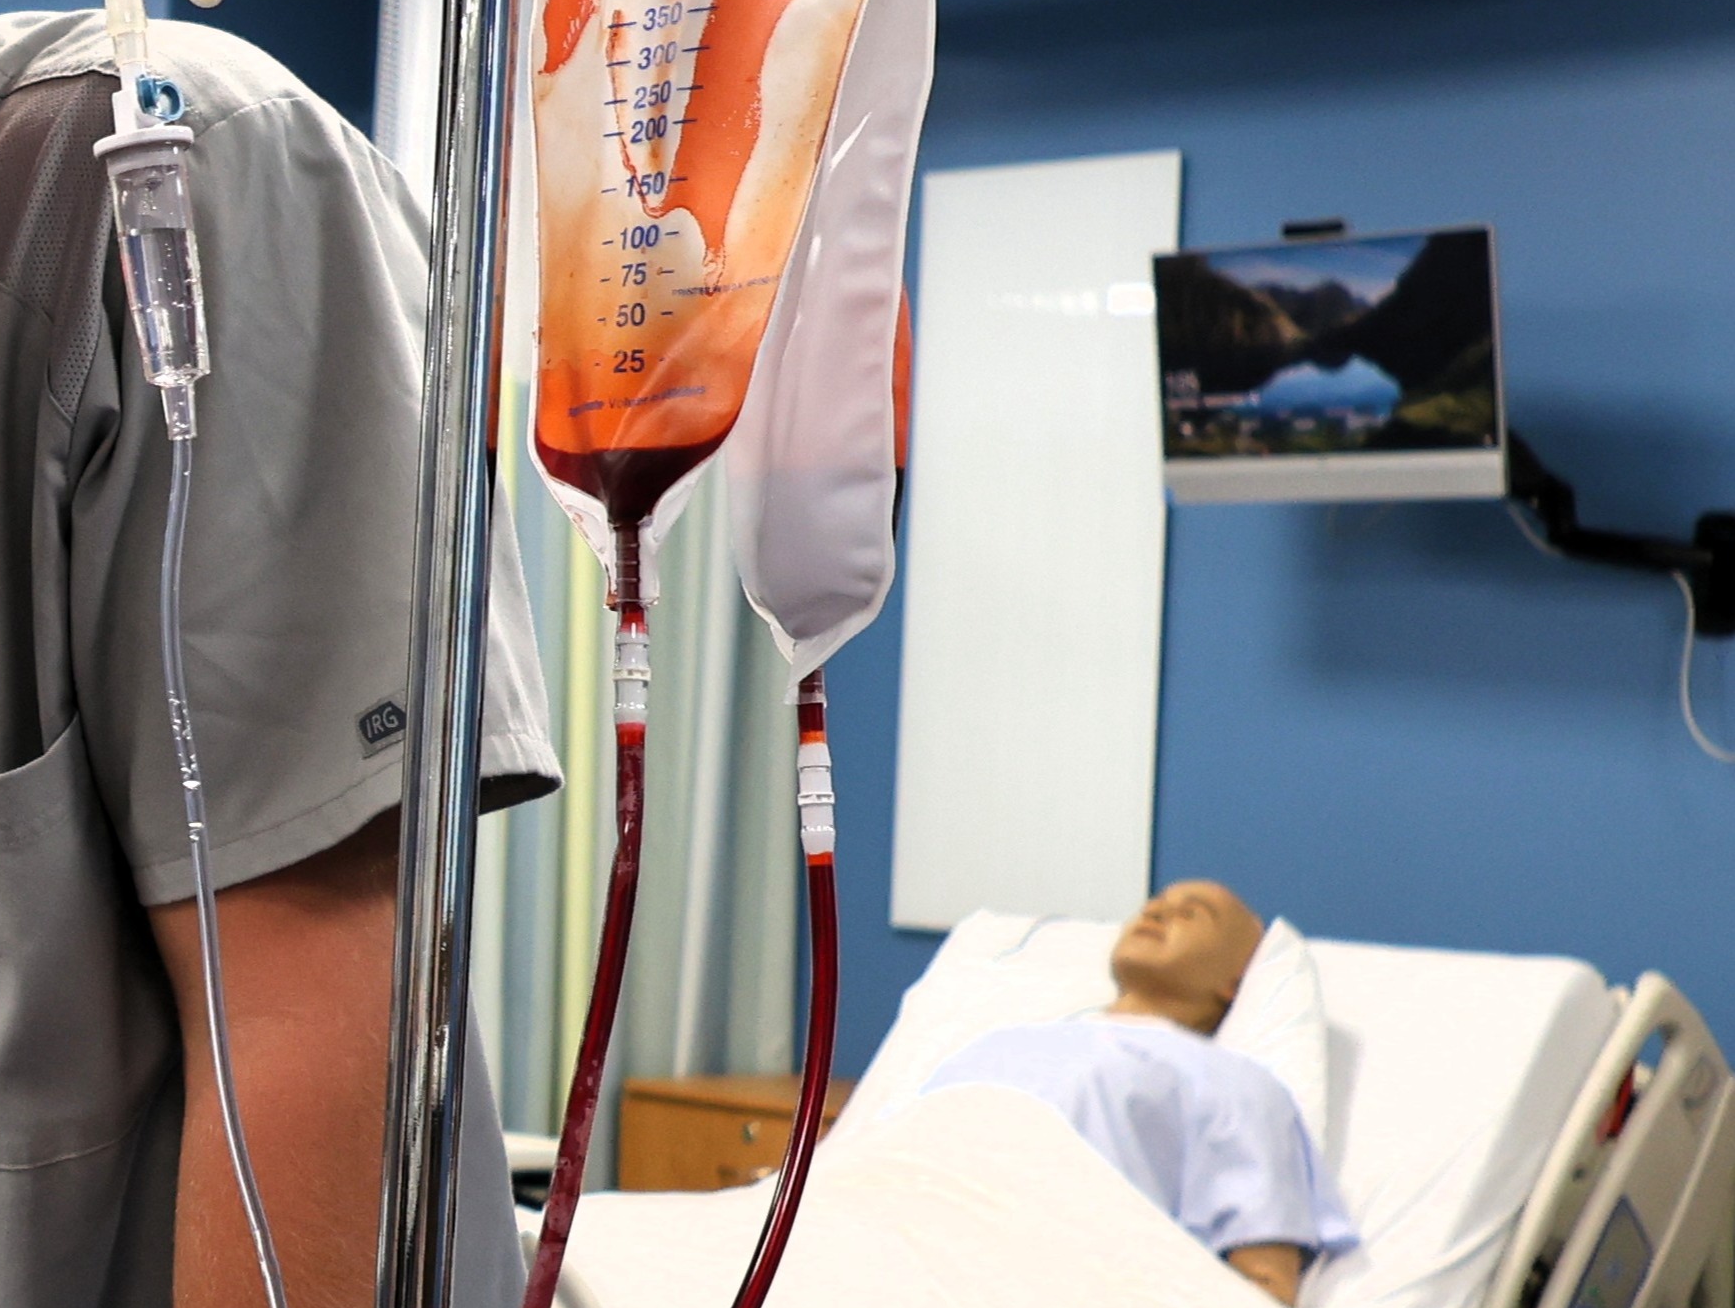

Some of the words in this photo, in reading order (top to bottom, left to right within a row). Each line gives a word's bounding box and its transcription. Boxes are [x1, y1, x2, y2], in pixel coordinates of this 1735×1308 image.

[642, 1, 683, 31] 350
[637, 41, 678, 70] 300
[633, 80, 672, 109] 250
[630, 114, 668, 144] 200
[625, 171, 665, 198] 150
[620, 224, 660, 250] 100
[621, 262, 647, 286] 75
[615, 302, 646, 328] 50
[612, 349, 646, 374] 25
